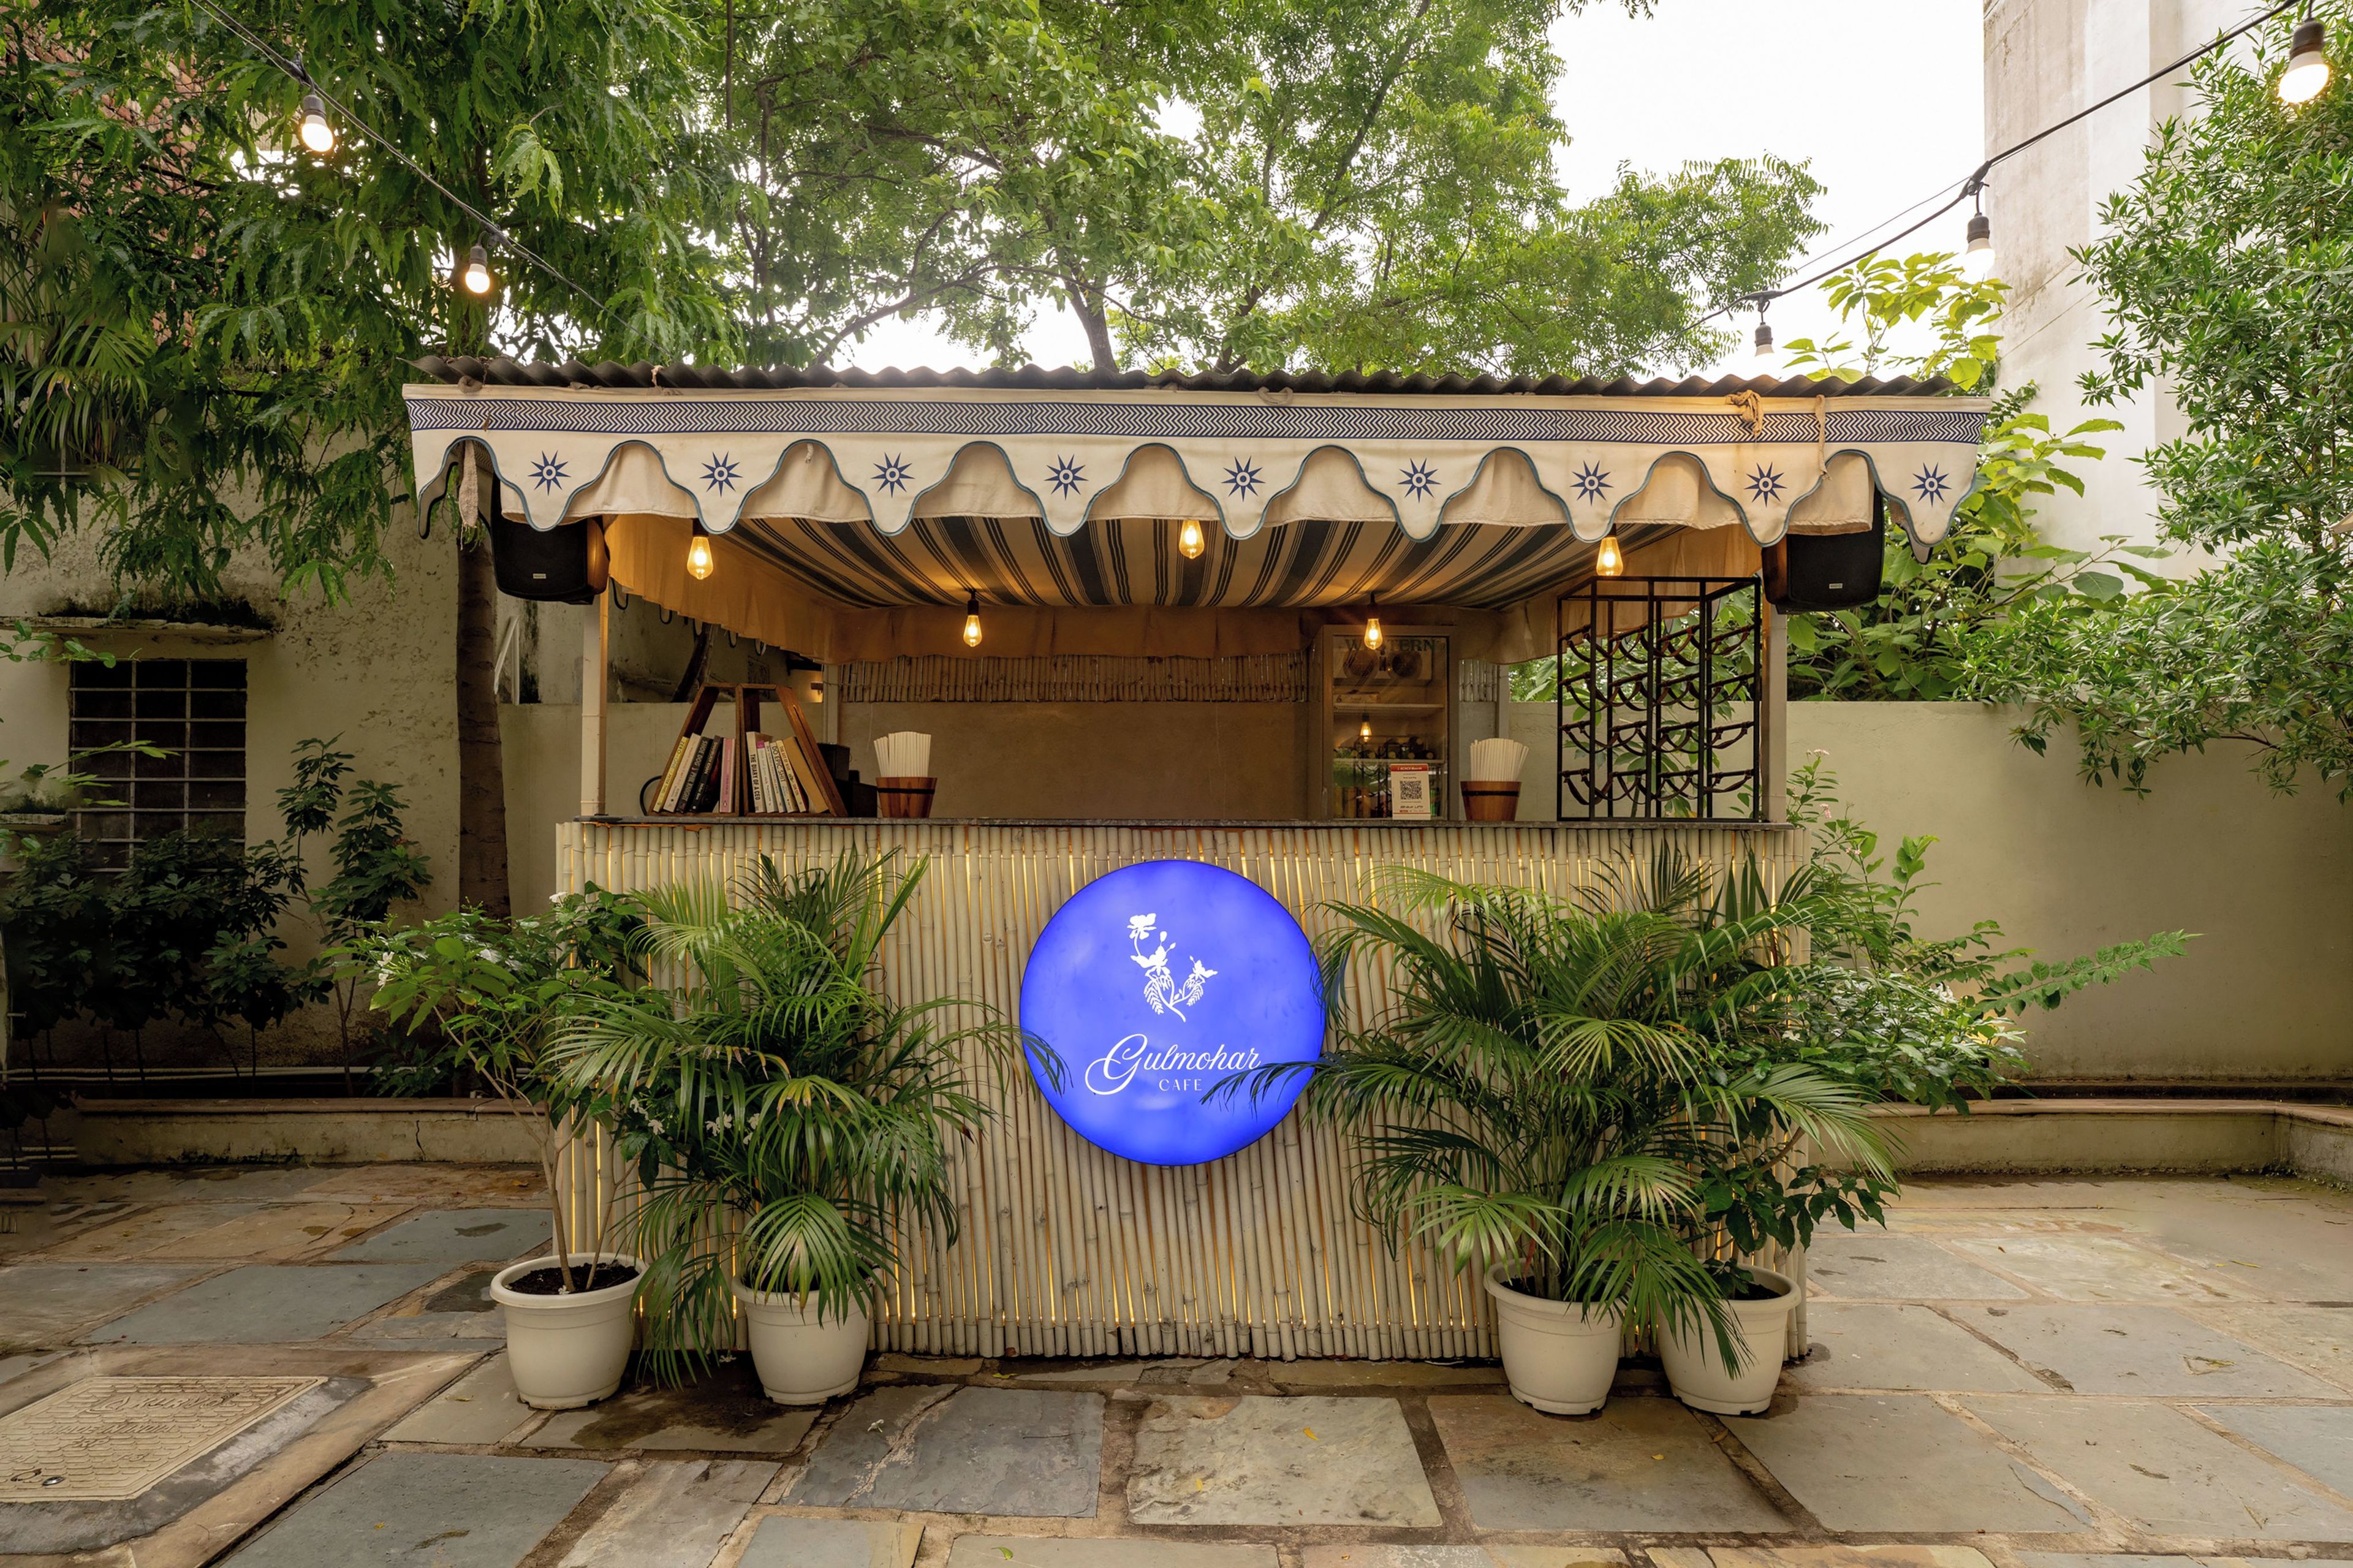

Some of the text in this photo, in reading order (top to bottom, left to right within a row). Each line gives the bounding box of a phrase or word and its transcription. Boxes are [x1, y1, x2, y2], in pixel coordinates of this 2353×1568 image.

[699, 740, 707, 754] SHOE
[771, 746, 778, 754] DO
[682, 782, 692, 801] KNIGHT
[1085, 1034, 1262, 1095] Gulmohar
[1159, 1078, 1203, 1091] CAFE
[40, 1425, 176, 1434] MADE IN INDIA
[65, 1438, 110, 1447] FRP
